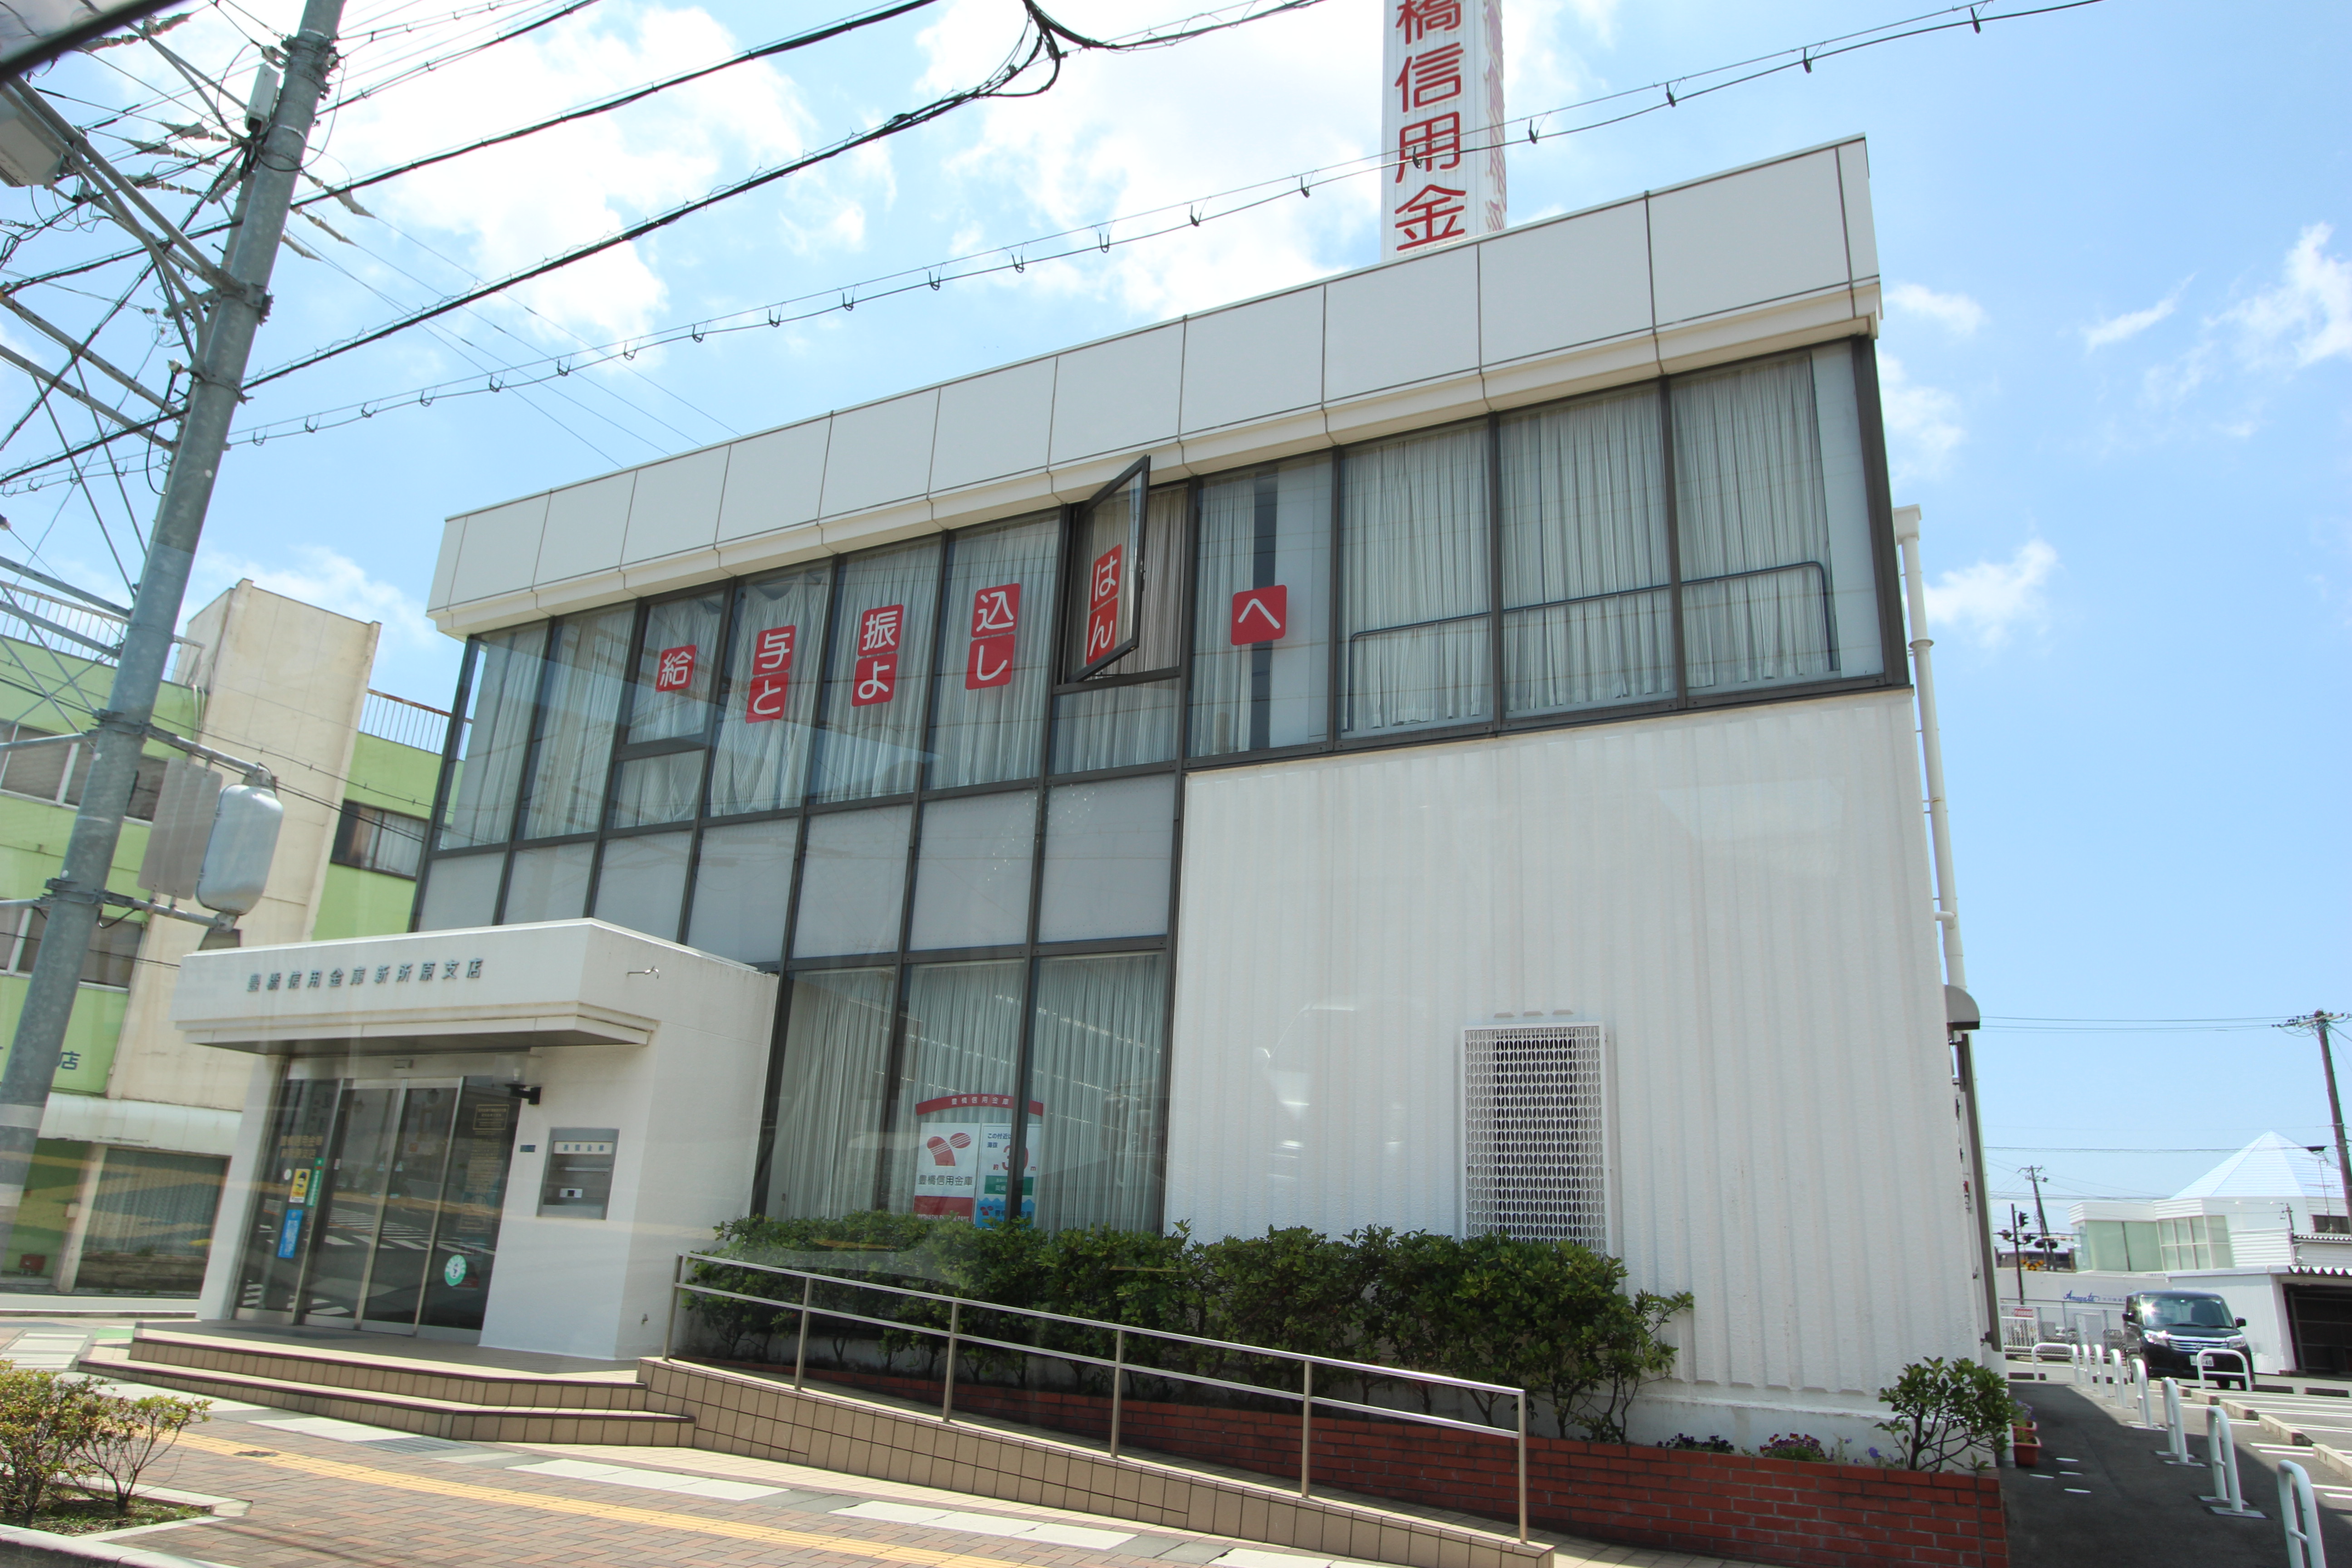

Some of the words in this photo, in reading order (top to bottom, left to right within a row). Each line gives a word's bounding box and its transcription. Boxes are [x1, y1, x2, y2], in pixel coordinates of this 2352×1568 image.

[951, 1096, 1009, 1105] 豊橋信用金庫
[918, 1175, 973, 1186] 豊橋信用金庫
